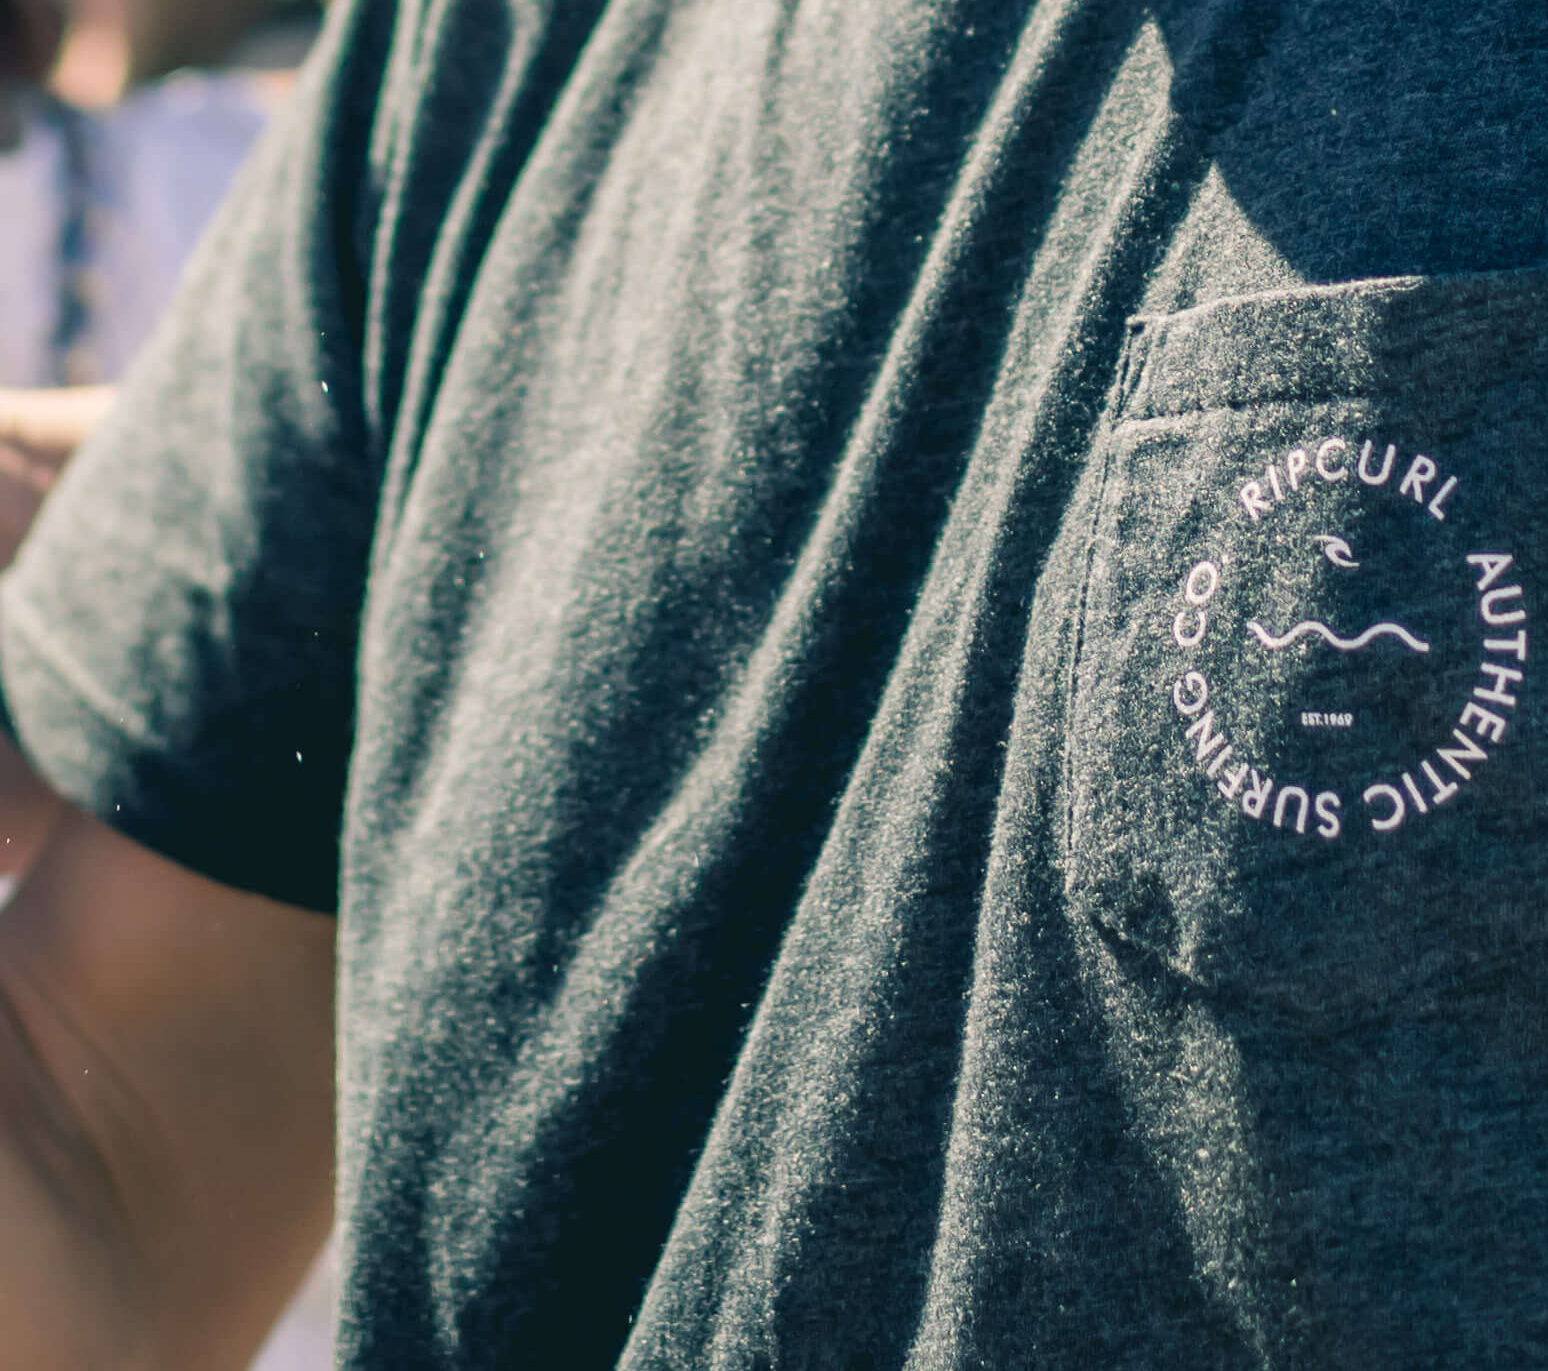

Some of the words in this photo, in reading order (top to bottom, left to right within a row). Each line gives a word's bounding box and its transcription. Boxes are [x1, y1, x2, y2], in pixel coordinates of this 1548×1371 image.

[1240, 438, 1458, 521] RIPCURL
[1173, 670, 1342, 838] SURFING
[1364, 552, 1527, 831] AUTHENTIC
